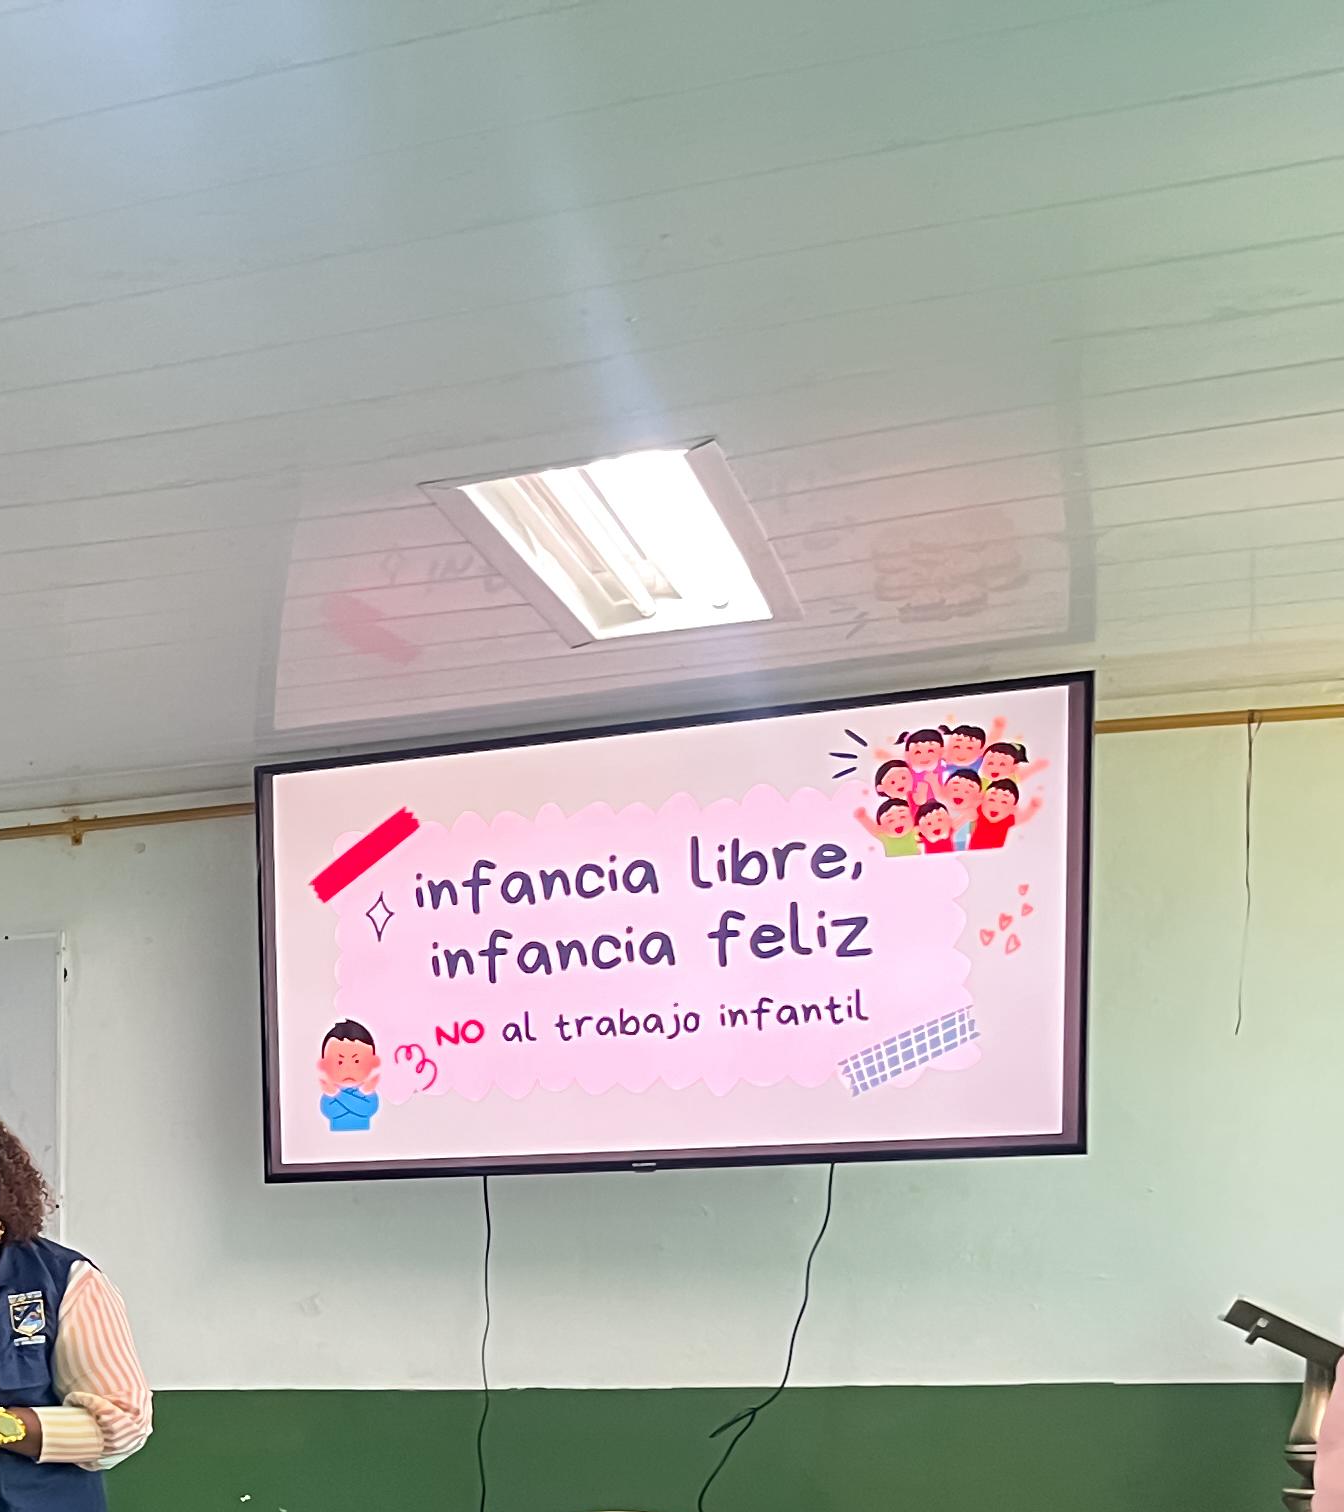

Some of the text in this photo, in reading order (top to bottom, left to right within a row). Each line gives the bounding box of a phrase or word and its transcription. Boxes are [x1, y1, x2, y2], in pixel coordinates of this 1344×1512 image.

[415, 835, 862, 914] infancia libre,
[431, 901, 873, 984] infancia feliz
[435, 989, 869, 1046] NO al trabajo infantil
